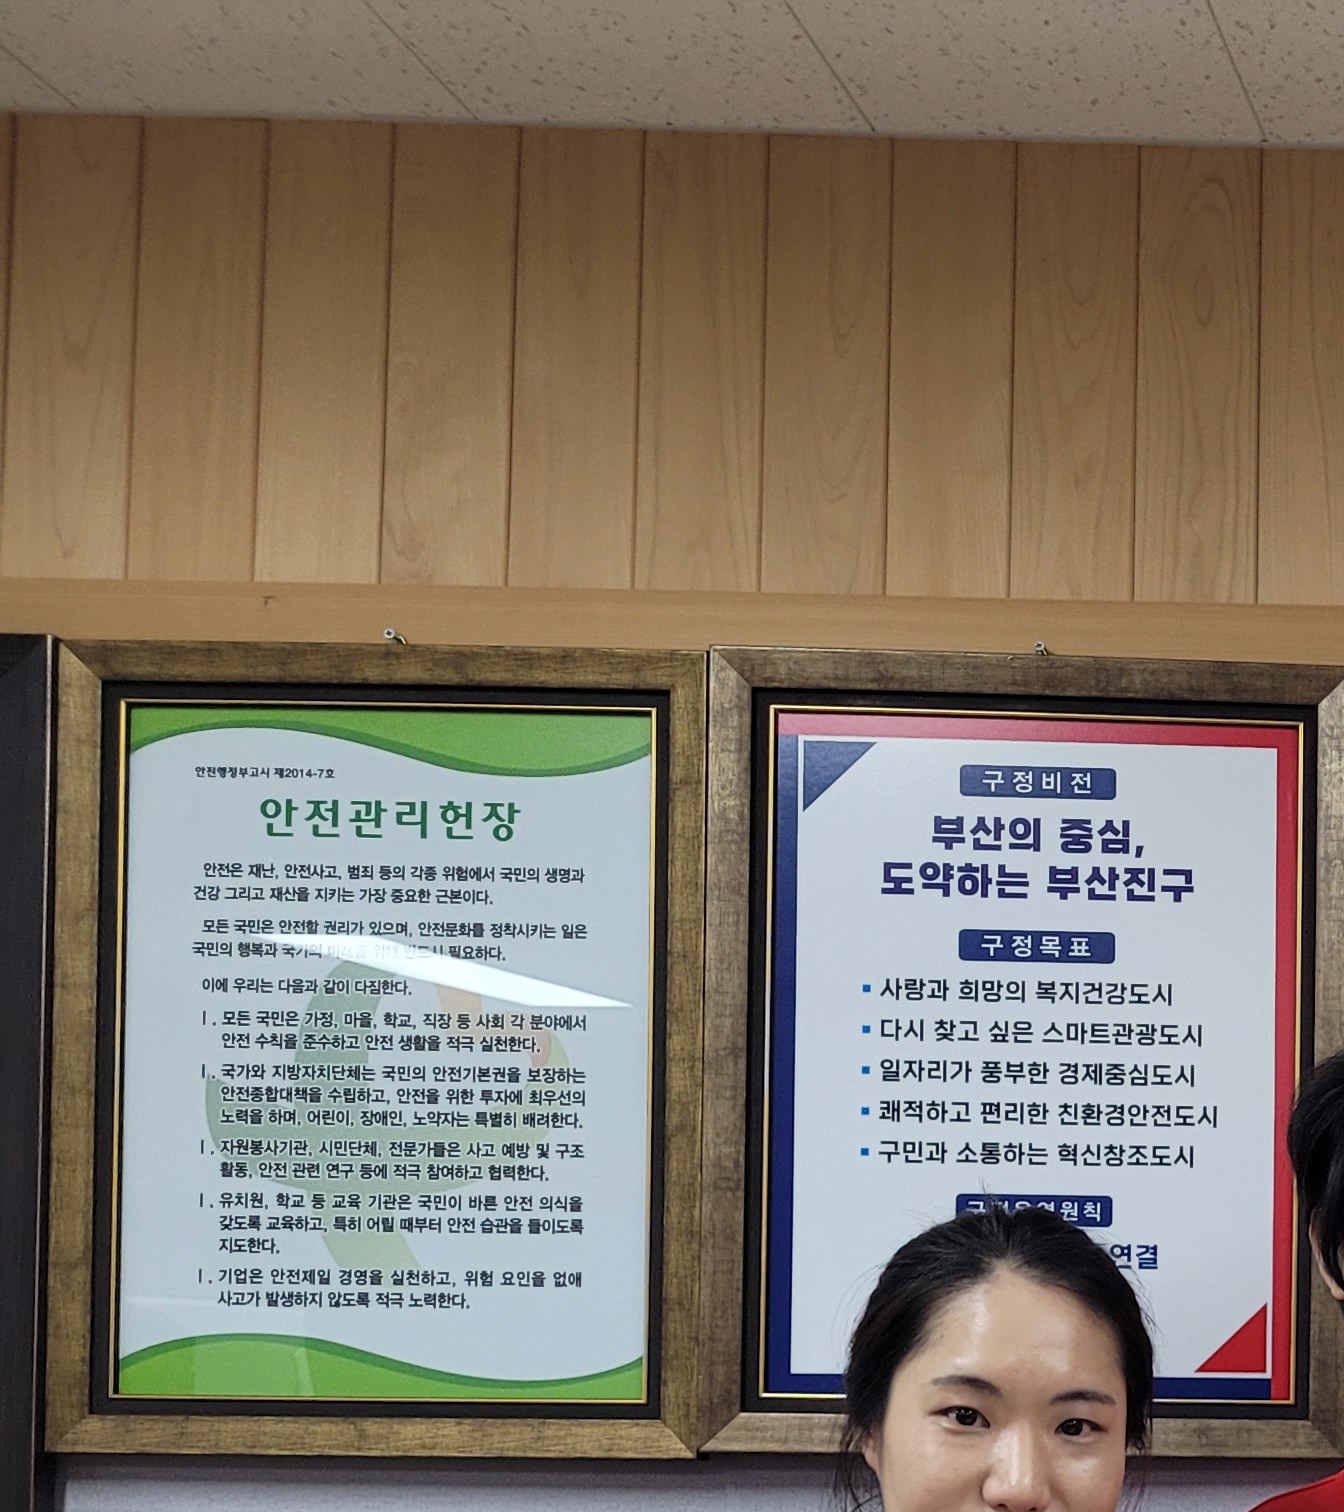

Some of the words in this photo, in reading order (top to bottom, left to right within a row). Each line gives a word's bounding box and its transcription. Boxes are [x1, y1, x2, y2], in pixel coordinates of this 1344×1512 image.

[982, 771, 1091, 793] 구정비전
[260, 799, 521, 841] 안전관리헌장
[932, 815, 1041, 852] 부산의
[1060, 818, 1144, 858] 중심,
[203, 862, 243, 877] 안전은
[248, 863, 278, 879] 재난,
[284, 864, 341, 880] 안전사고,
[347, 864, 373, 880] 범죄
[378, 865, 405, 880] 등의
[410, 865, 437, 881] 각종
[442, 866, 494, 882] 위험에서
[499, 867, 539, 883] 국민의
[544, 868, 585, 883] 생명과
[881, 862, 1029, 899] 도약하는
[1047, 865, 1194, 902] 부산진구
[981, 935, 1090, 957] 구정목표
[202, 977, 228, 992] 이에
[232, 978, 273, 993] 우리는
[278, 978, 318, 994] 다음과
[323, 979, 350, 994] 같이
[354, 975, 416, 995] 다짐한다.
[880, 978, 949, 1001] 사랑과
[958, 979, 1025, 1003] 희망의
[1035, 981, 1172, 1006] 복지건강도시
[880, 1018, 924, 1041] 다시
[934, 1019, 979, 1042] 찾고
[988, 1021, 1033, 1043] 싶은
[1042, 1022, 1202, 1047] 스마트관광도시
[880, 1059, 972, 1083] 일자리가
[980, 1061, 1049, 1084] 풍부한
[1059, 1063, 1194, 1087] 경제중심도시
[879, 1100, 971, 1123] 쾌적하고
[980, 1102, 1049, 1125] 편리한
[1058, 1102, 1217, 1128] 친환경안전도시
[878, 1141, 947, 1164] 구민과
[956, 1142, 1048, 1165] 소통하는
[1058, 1143, 1193, 1168] 혁신창조도시
[218, 1268, 263, 1284] 기업은
[270, 1268, 330, 1285] 안전제일
[338, 1269, 383, 1285] 경영을
[390, 1270, 455, 1287] 실천하고,
[464, 1270, 493, 1287] 위험
[500, 1271, 546, 1287] 요인을
[553, 1271, 581, 1287] 없애
[218, 1290, 261, 1307] 사고가
[266, 1291, 322, 1308] 발생하지
[328, 1291, 370, 1308] 않도록
[376, 1292, 404, 1308] 적극
[408, 1292, 470, 1309] 노력한다.
